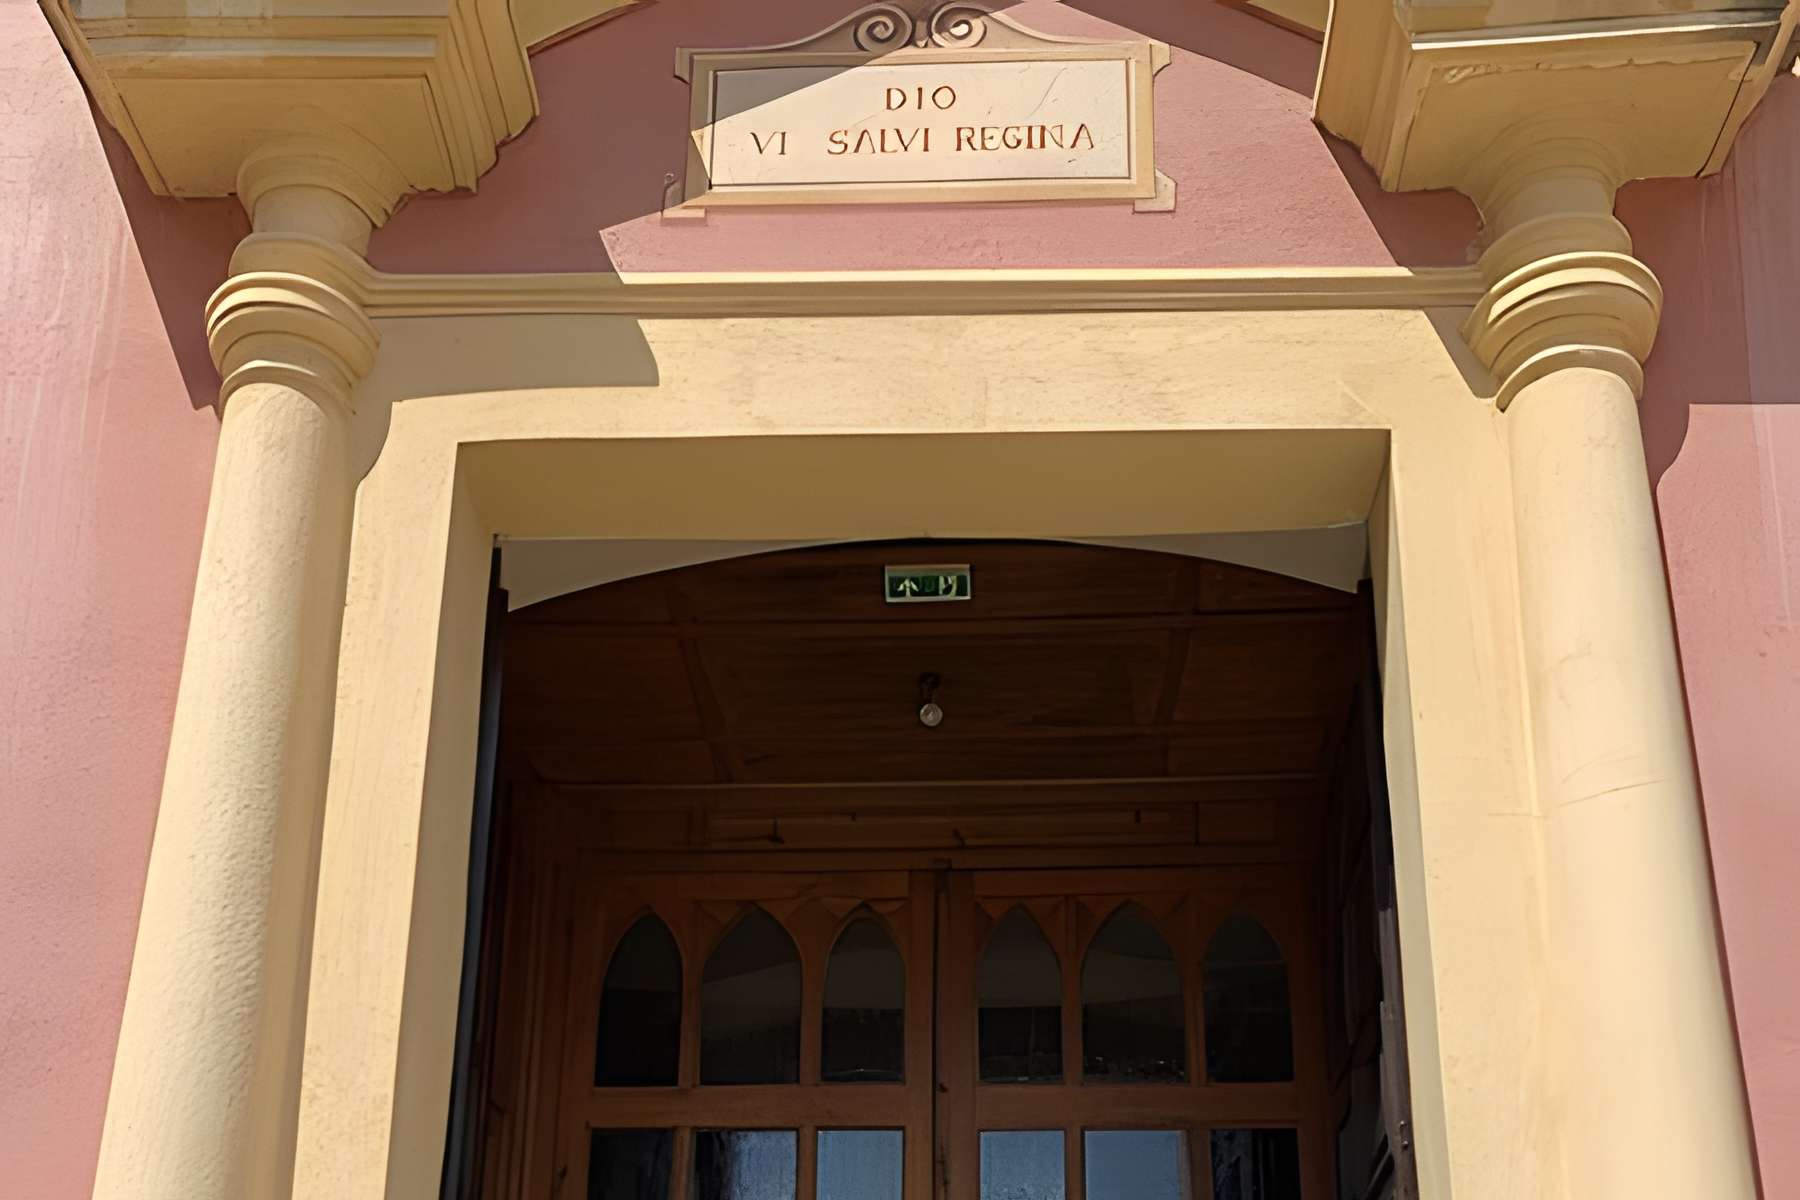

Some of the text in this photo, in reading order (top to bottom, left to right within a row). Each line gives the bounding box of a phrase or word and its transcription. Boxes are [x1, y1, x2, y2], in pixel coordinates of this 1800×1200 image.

[886, 86, 957, 112] DIO
[751, 123, 1095, 156] VI SALVI REGINA
